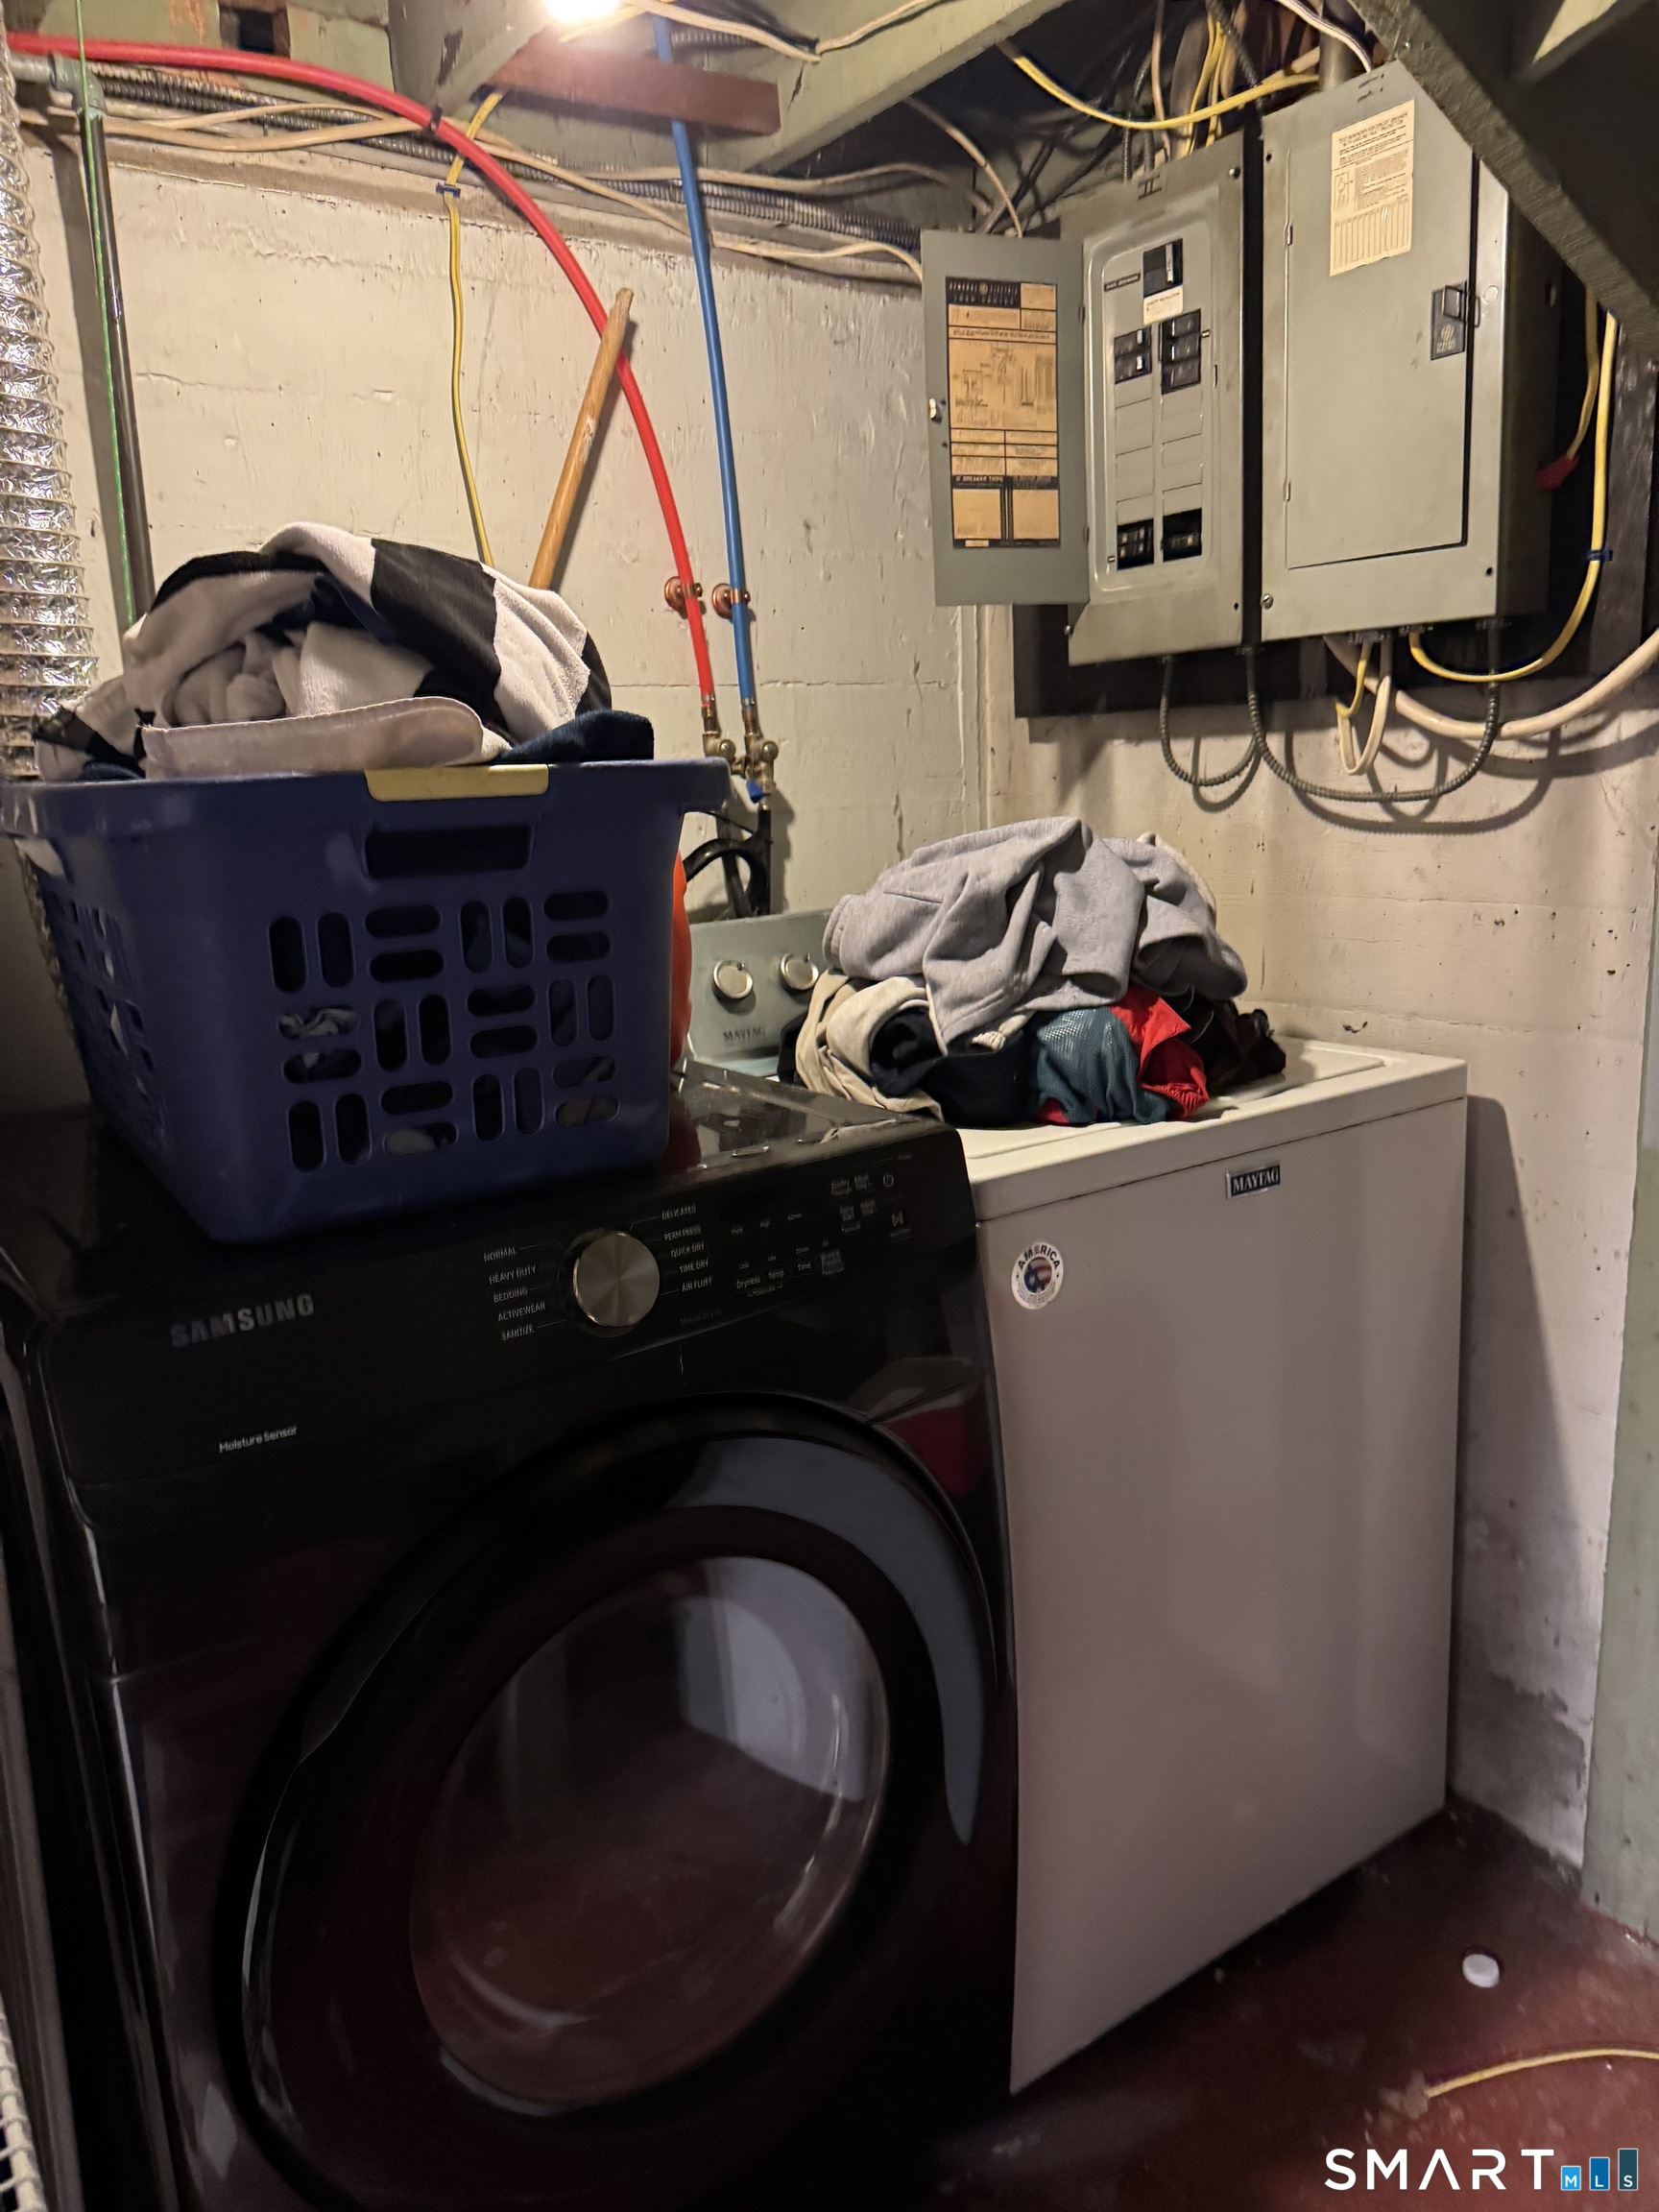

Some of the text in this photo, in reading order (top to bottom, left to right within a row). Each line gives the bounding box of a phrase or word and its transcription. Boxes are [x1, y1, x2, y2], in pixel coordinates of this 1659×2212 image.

[1232, 1166, 1280, 1194] MAYTAG
[664, 1231, 682, 1241] PERM
[483, 1246, 518, 1262] NORMAL
[670, 1245, 691, 1258] QUICK
[1018, 1244, 1061, 1271] AMERICA
[489, 1263, 537, 1285] HEAVY DUTY
[679, 1257, 709, 1274] TIME DRY
[682, 1275, 713, 1292] AIR FLUFF
[736, 1276, 761, 1289] Dryness
[493, 1285, 529, 1304] BEDDING
[170, 1293, 315, 1348] SAMSUNG
[497, 1300, 546, 1323] ACTIVEWEAR
[218, 1425, 299, 1454] Moisture Sensor
